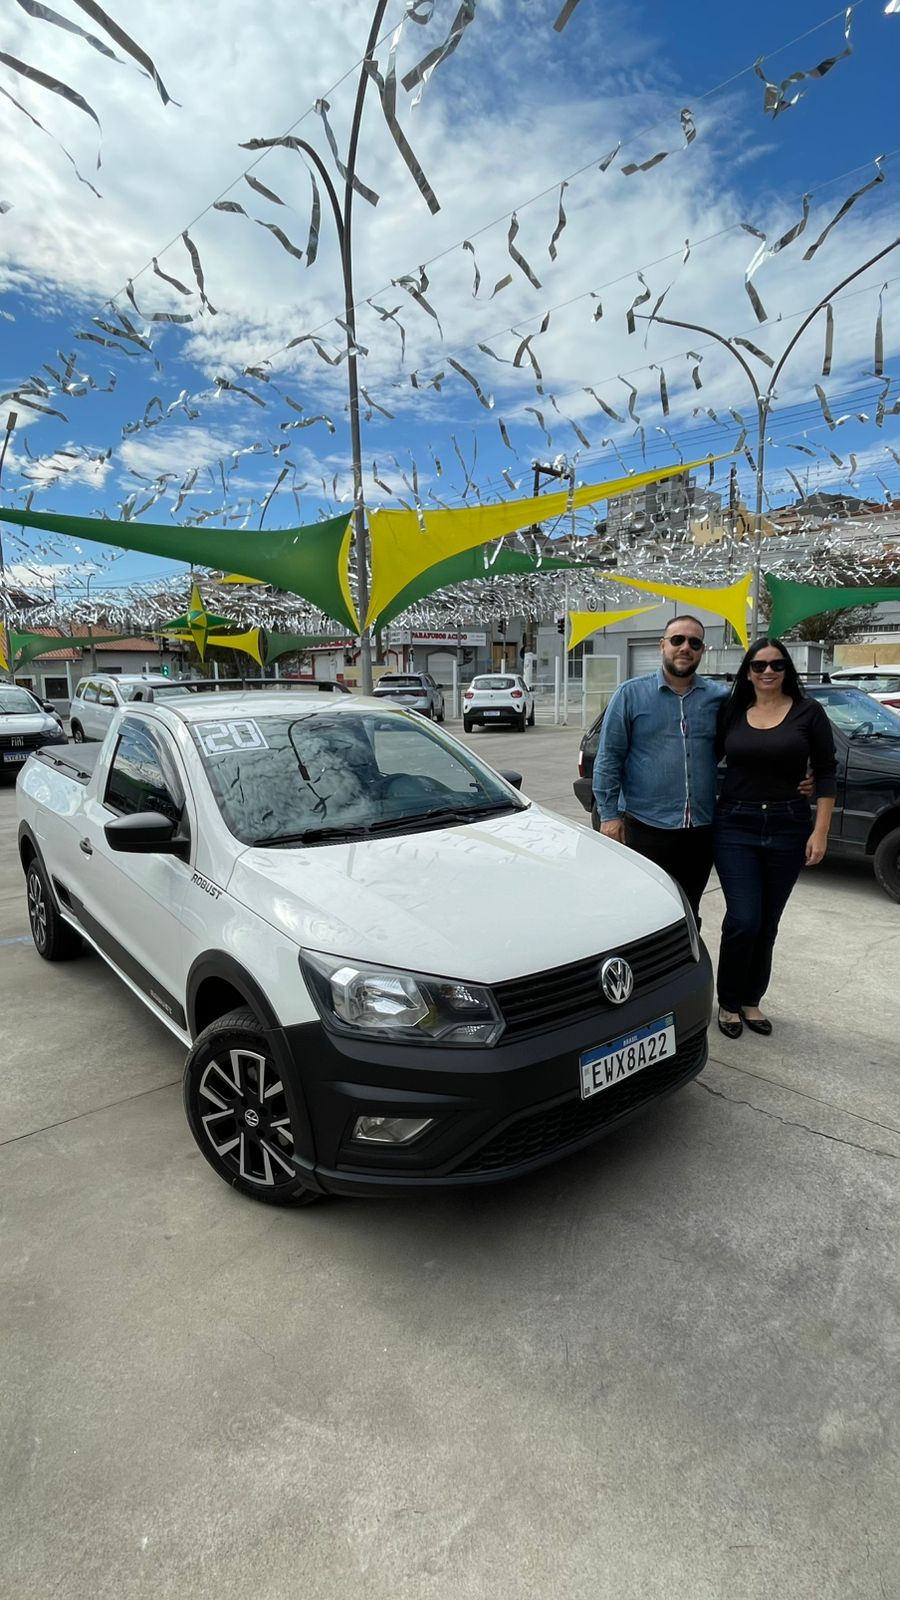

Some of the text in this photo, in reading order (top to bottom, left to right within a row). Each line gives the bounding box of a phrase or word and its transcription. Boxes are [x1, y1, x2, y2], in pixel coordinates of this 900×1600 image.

[11, 736, 24, 746] FIAT
[202, 721, 261, 751] 20
[191, 873, 223, 900] ROBUST
[591, 1032, 667, 1089] EWX8A22
